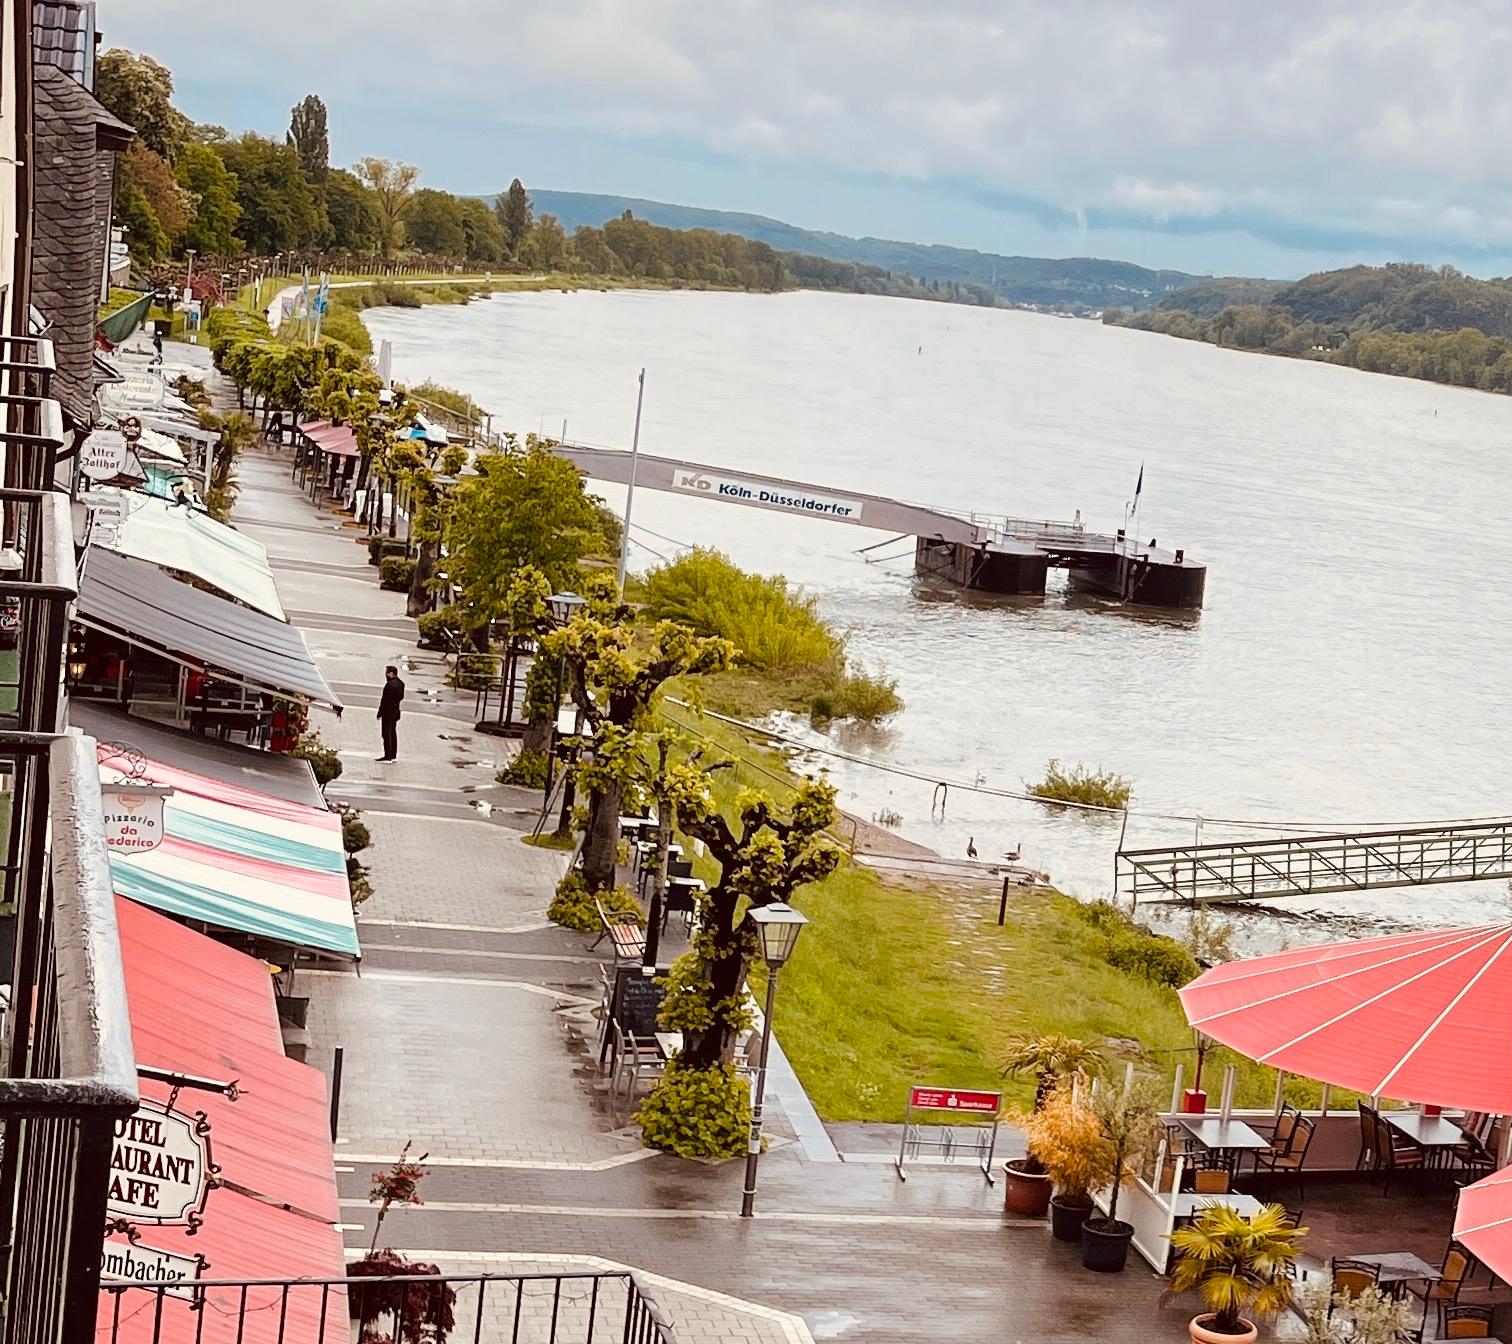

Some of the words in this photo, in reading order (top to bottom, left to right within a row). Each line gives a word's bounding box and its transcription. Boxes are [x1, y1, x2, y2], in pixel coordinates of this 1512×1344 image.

[89, 447, 116, 458] Alter
[718, 482, 853, 517] Köln-Düsseldorfer
[104, 814, 155, 828] pizzeria
[120, 825, 138, 835] da
[107, 836, 154, 847] ederico
[114, 1115, 167, 1148] OTEL
[111, 1144, 195, 1185] AURANT
[107, 1175, 160, 1209] AFE
[100, 1249, 186, 1282] ombacher
